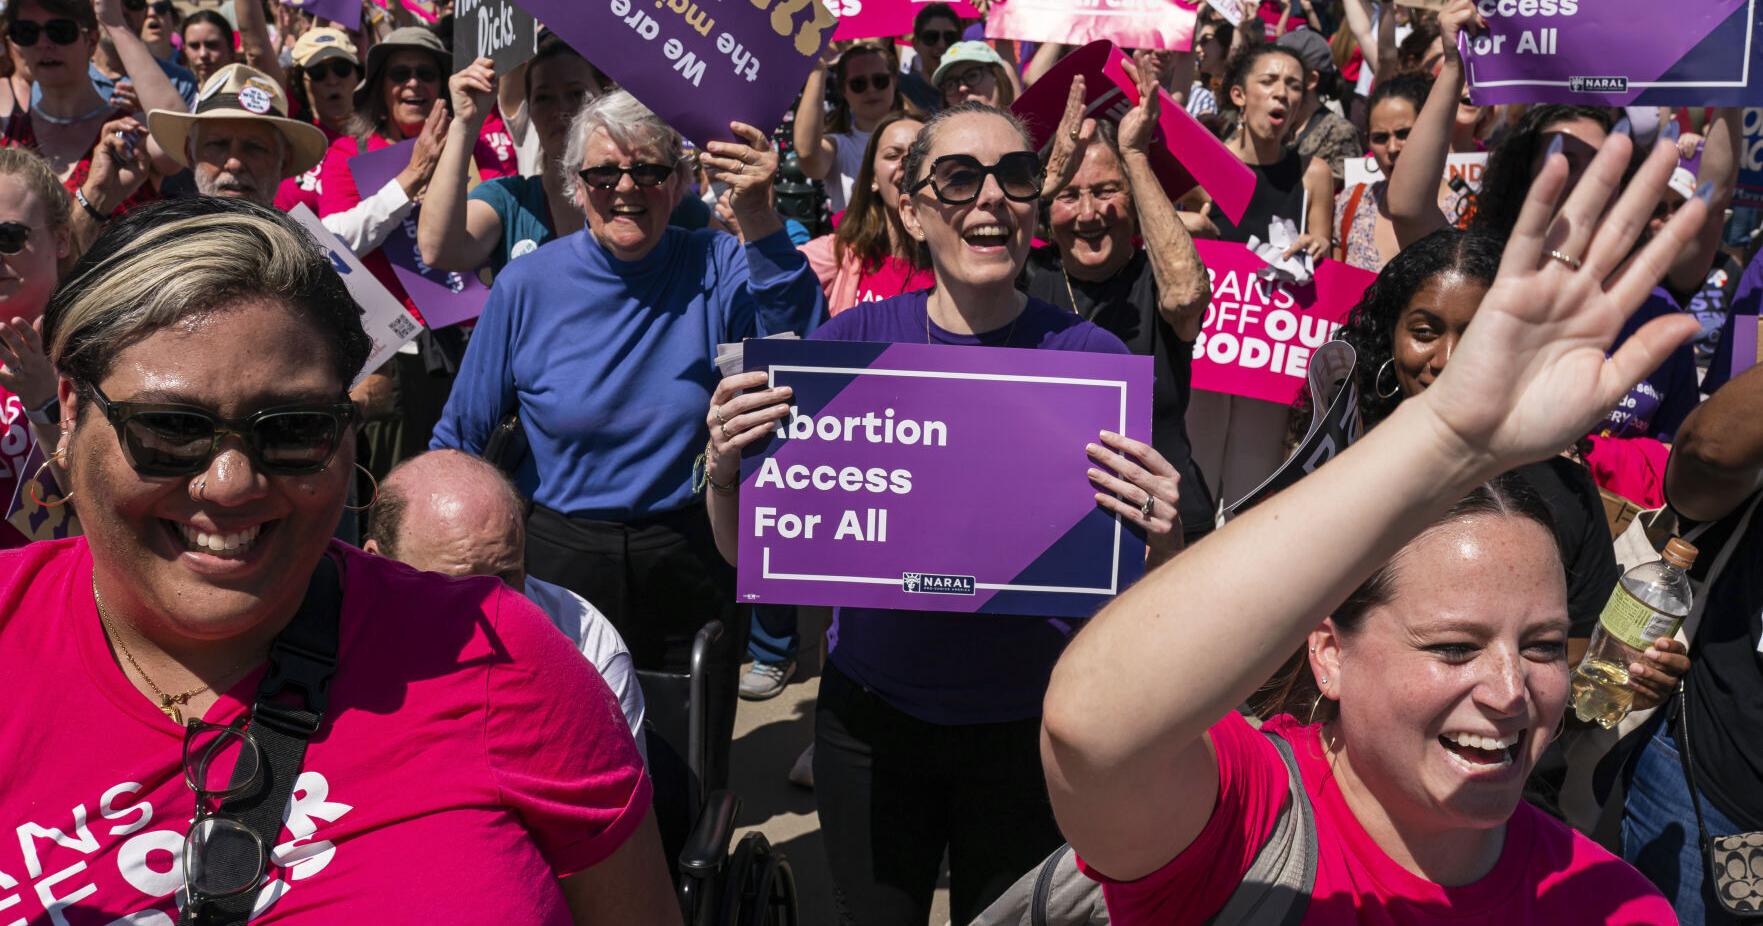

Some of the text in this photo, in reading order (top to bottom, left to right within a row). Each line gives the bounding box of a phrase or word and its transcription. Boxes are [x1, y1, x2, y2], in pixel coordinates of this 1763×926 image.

[1477, 0, 1578, 17] ccess
[716, 32, 761, 82] the
[1467, 28, 1557, 56] or All
[663, 38, 707, 88] We
[1585, 79, 1625, 88] NARAL
[1192, 332, 1311, 379] BODIE
[754, 457, 913, 494] Access
[754, 506, 888, 542] For All
[923, 577, 971, 588] NARAL
[117, 771, 354, 897] OR
